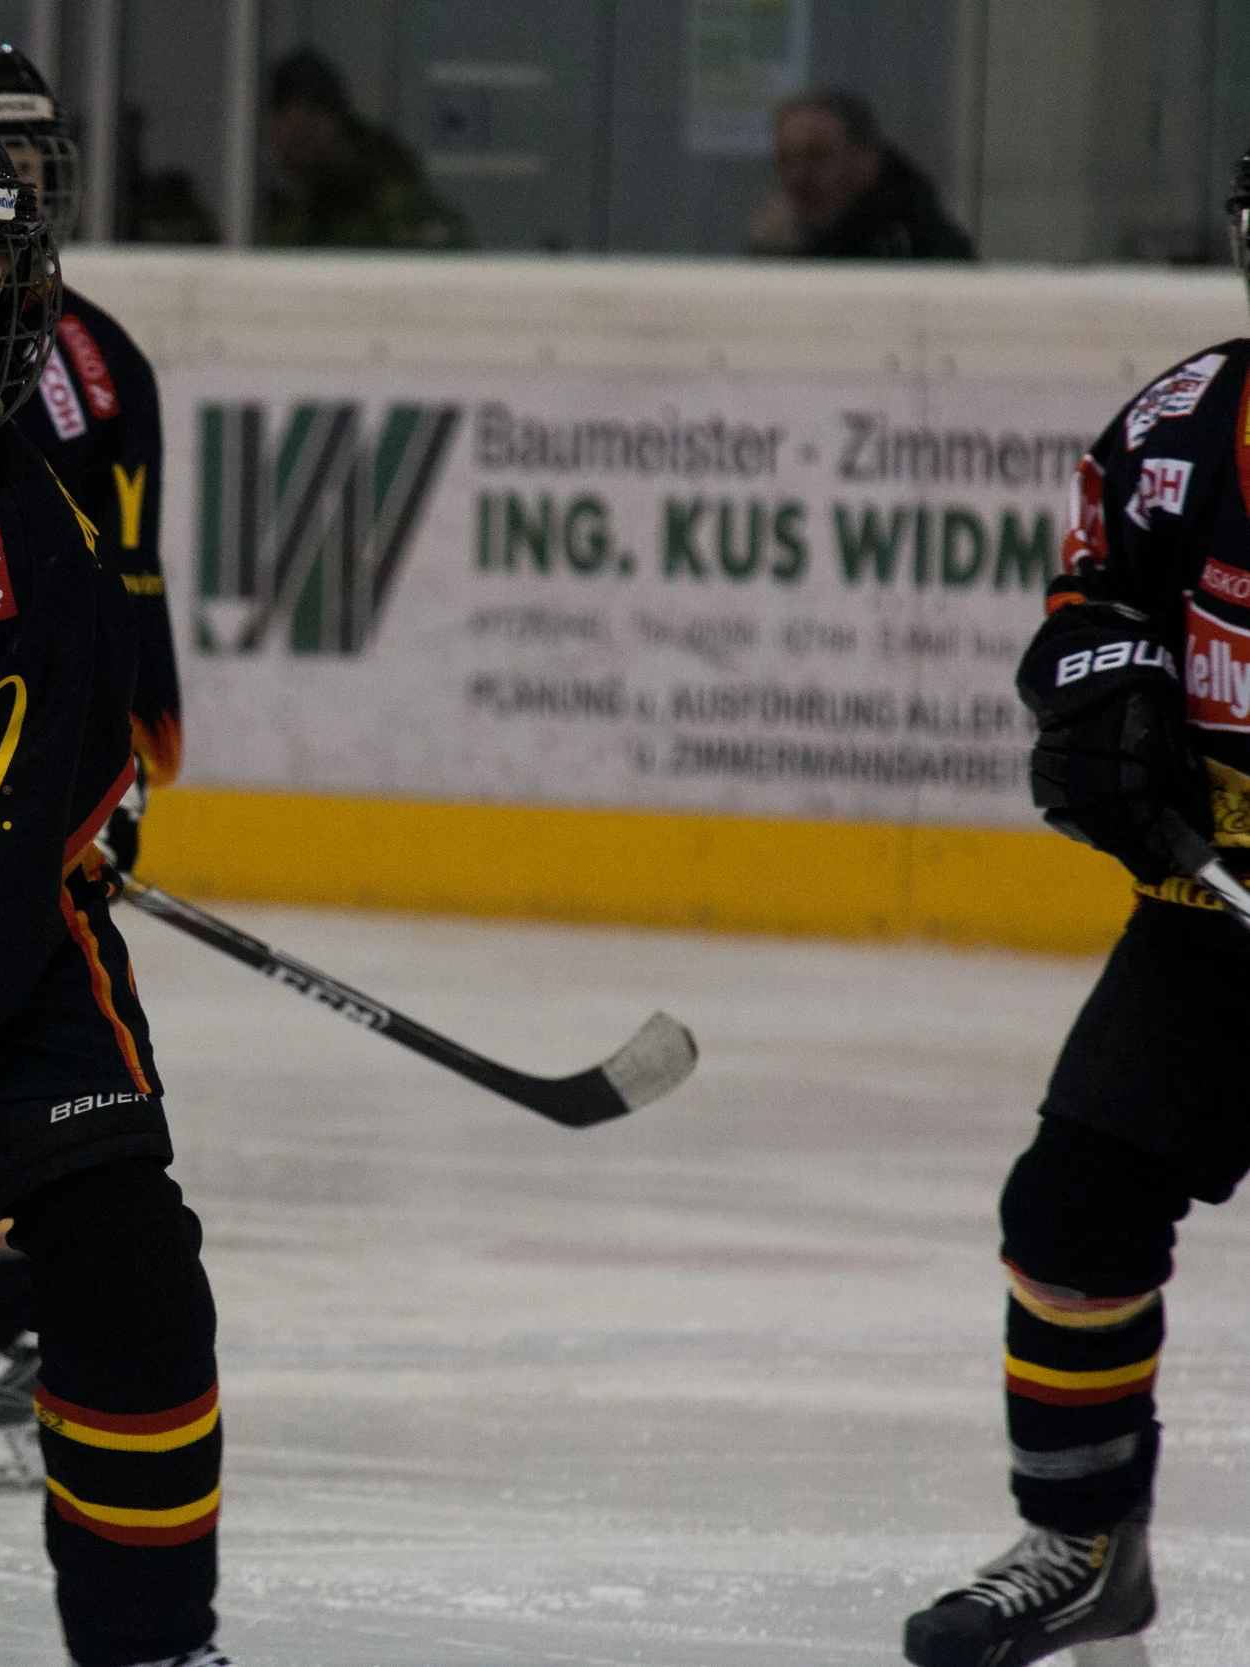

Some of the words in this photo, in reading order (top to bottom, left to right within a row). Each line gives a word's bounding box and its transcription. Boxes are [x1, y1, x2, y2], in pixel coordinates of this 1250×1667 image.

[473, 400, 787, 478] Baumeister
[478, 494, 636, 574] ING.
[664, 500, 805, 580] KUS
